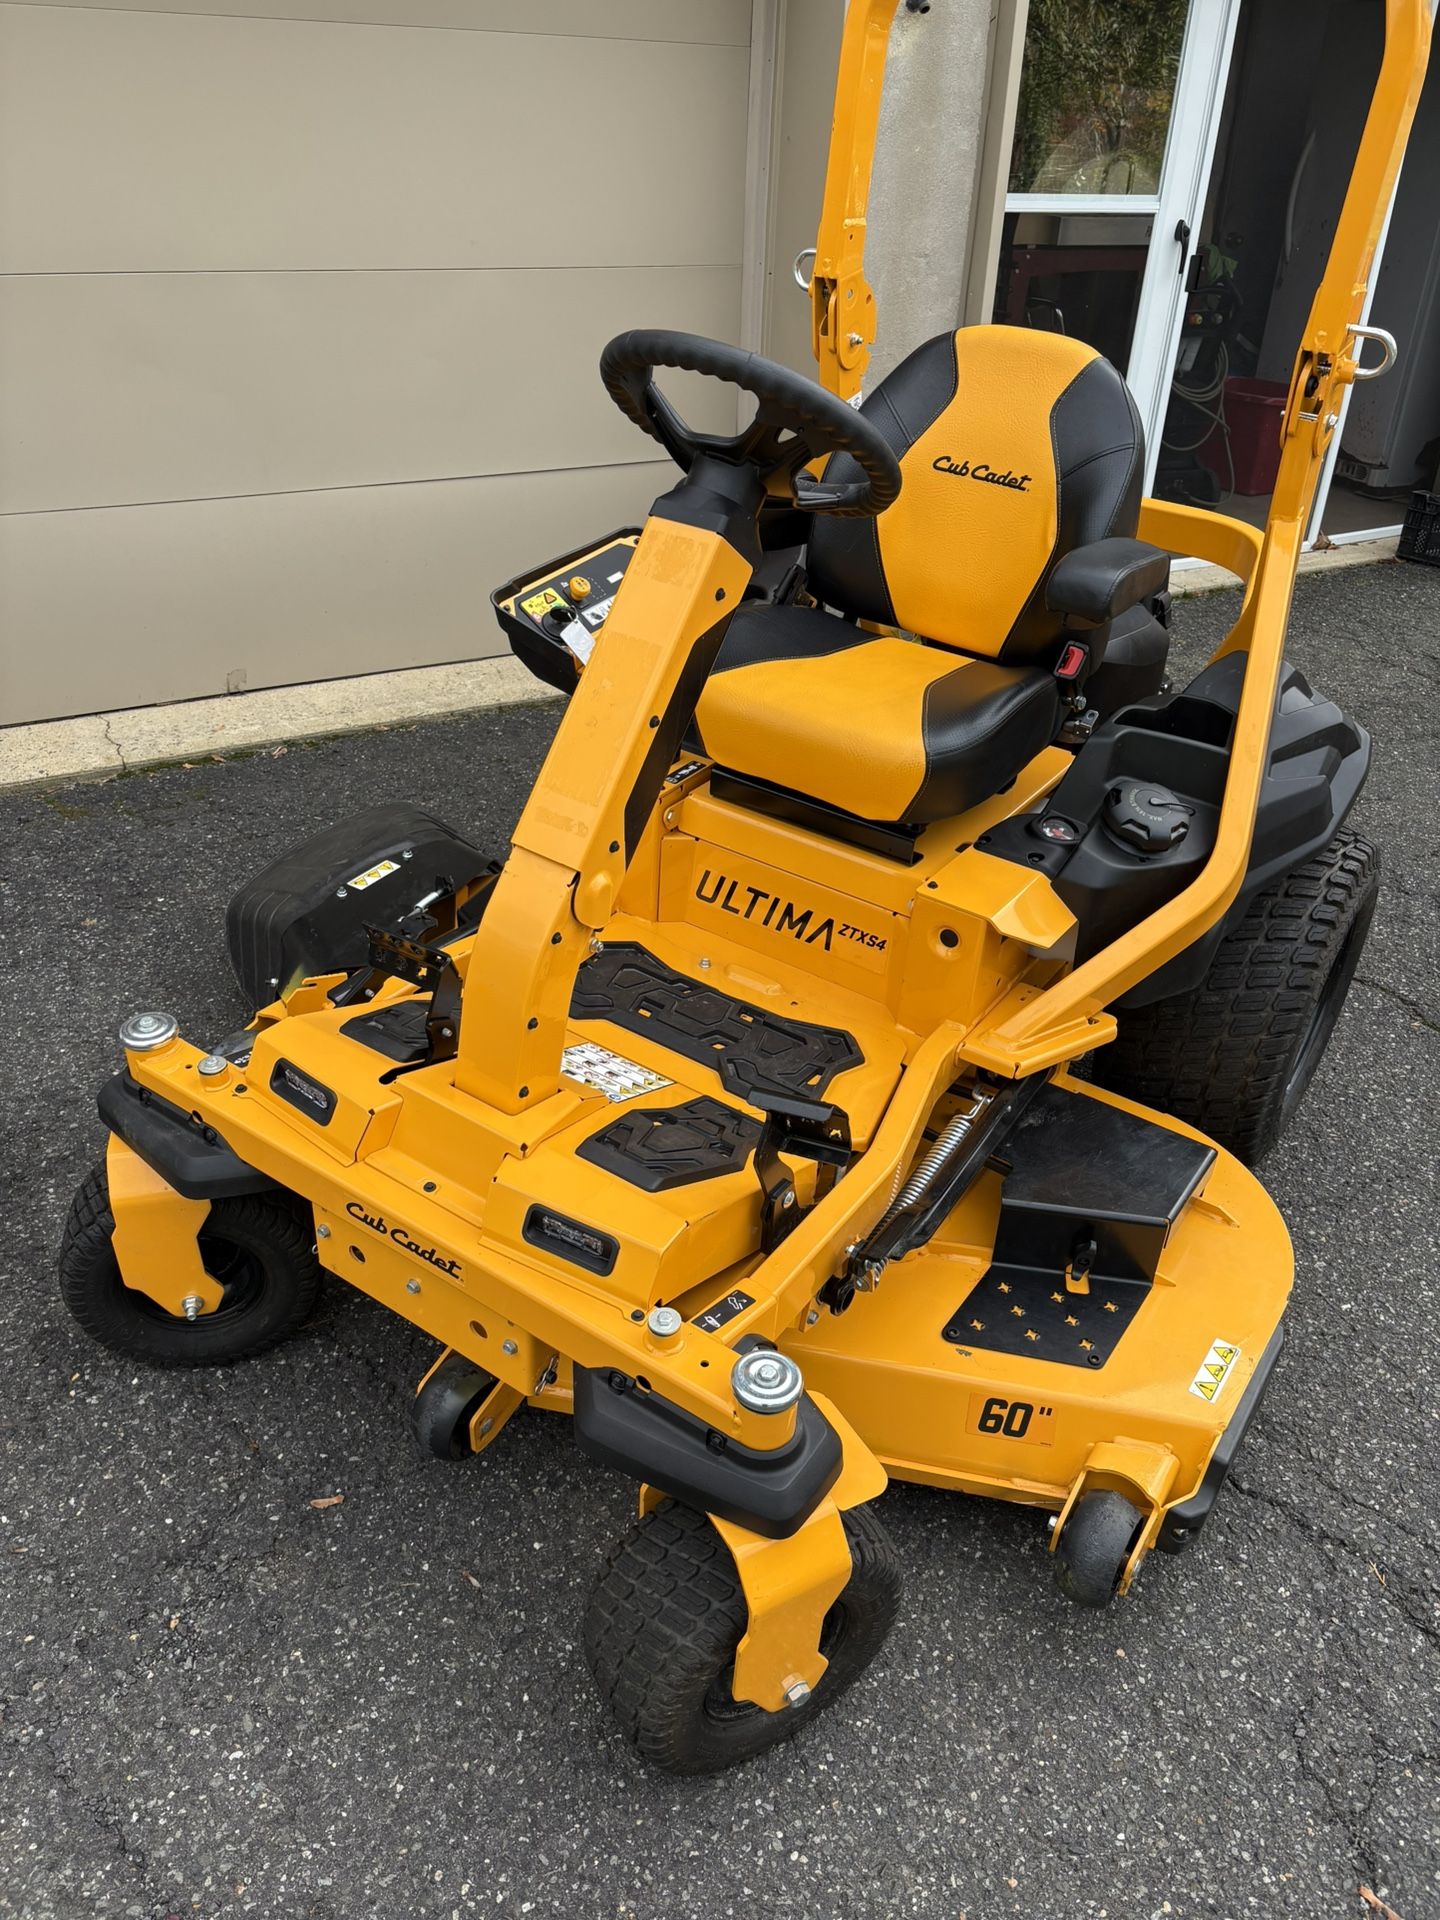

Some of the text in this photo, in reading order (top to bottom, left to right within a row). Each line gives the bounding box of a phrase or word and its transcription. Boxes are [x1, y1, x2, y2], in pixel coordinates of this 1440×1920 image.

[933, 456, 1032, 491] Cub Cadet
[695, 869, 888, 952] ULTIMA ZTXS4
[346, 1202, 462, 1279] Cub Cadet
[978, 1397, 1053, 1438] 60"
